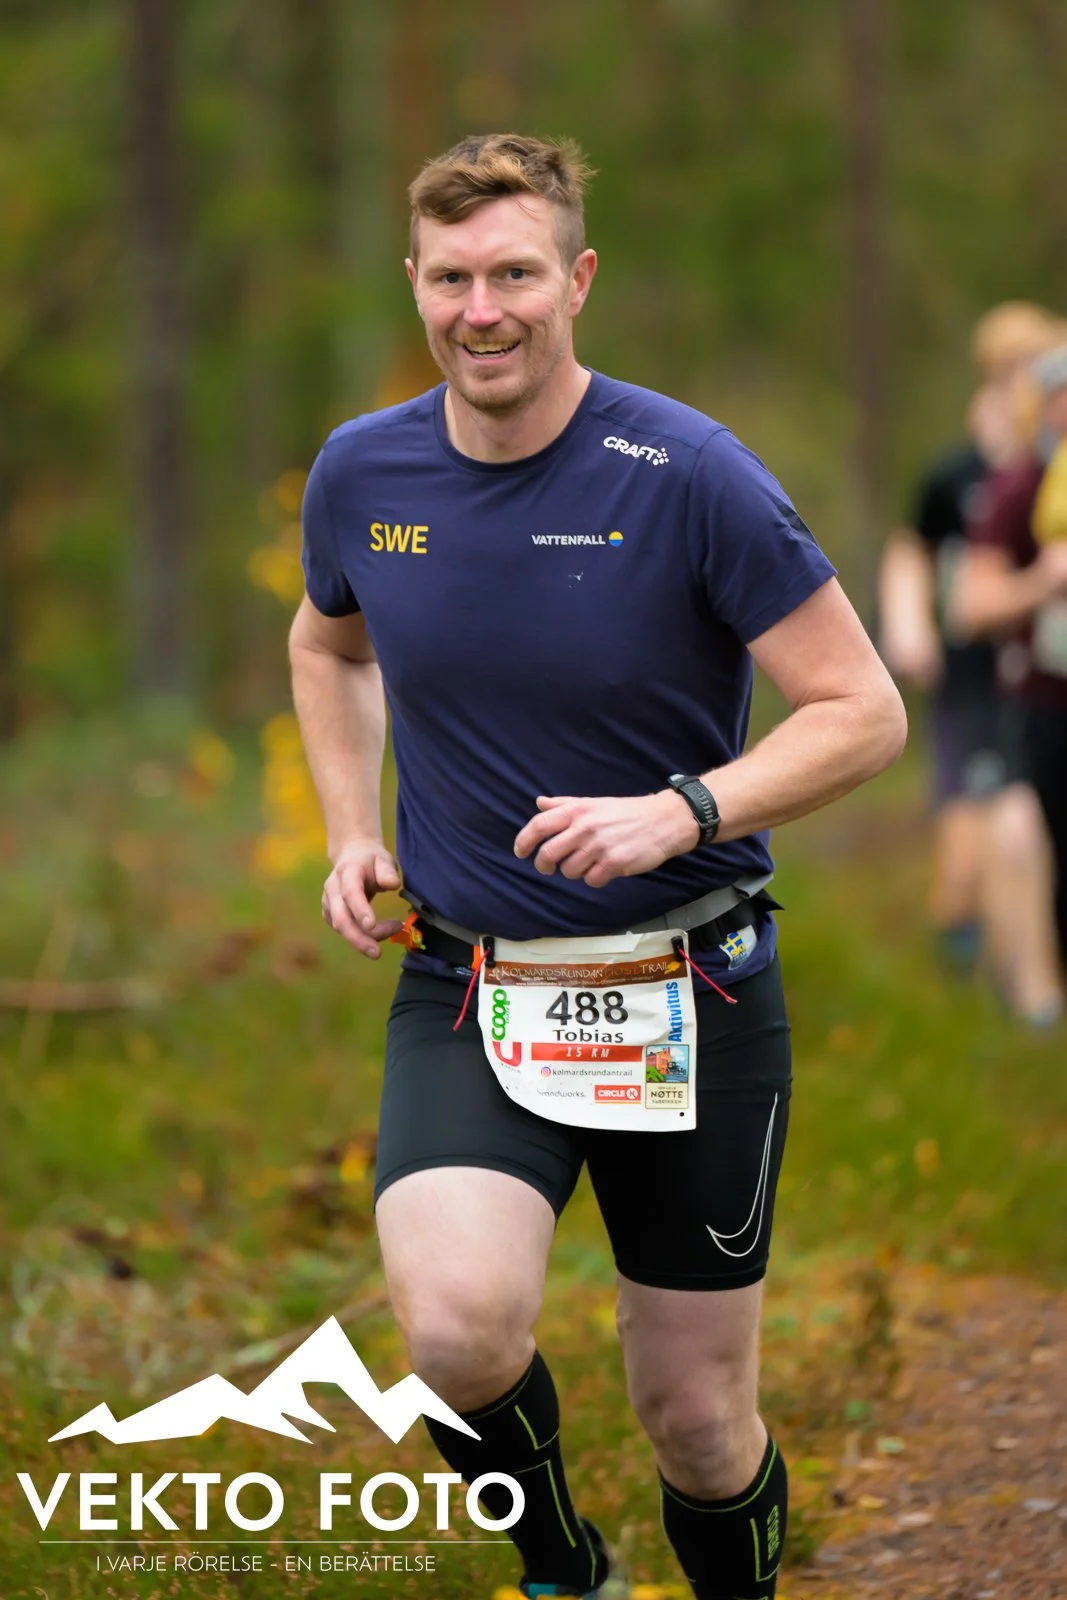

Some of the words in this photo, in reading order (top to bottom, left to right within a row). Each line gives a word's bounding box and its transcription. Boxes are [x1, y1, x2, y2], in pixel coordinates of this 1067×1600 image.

[603, 436, 658, 461] CRAFT
[370, 522, 429, 554] SWE
[531, 534, 606, 545] VATTENFALL
[492, 989, 510, 1040] coop
[545, 990, 629, 1026] 488
[665, 981, 682, 1042] Aktivitus
[552, 1028, 624, 1043] Tobias
[566, 1046, 582, 1058] 15
[591, 1047, 610, 1058] KM
[552, 1067, 633, 1077] kolmardsrundantrail
[597, 1089, 625, 1098] CIRCLE
